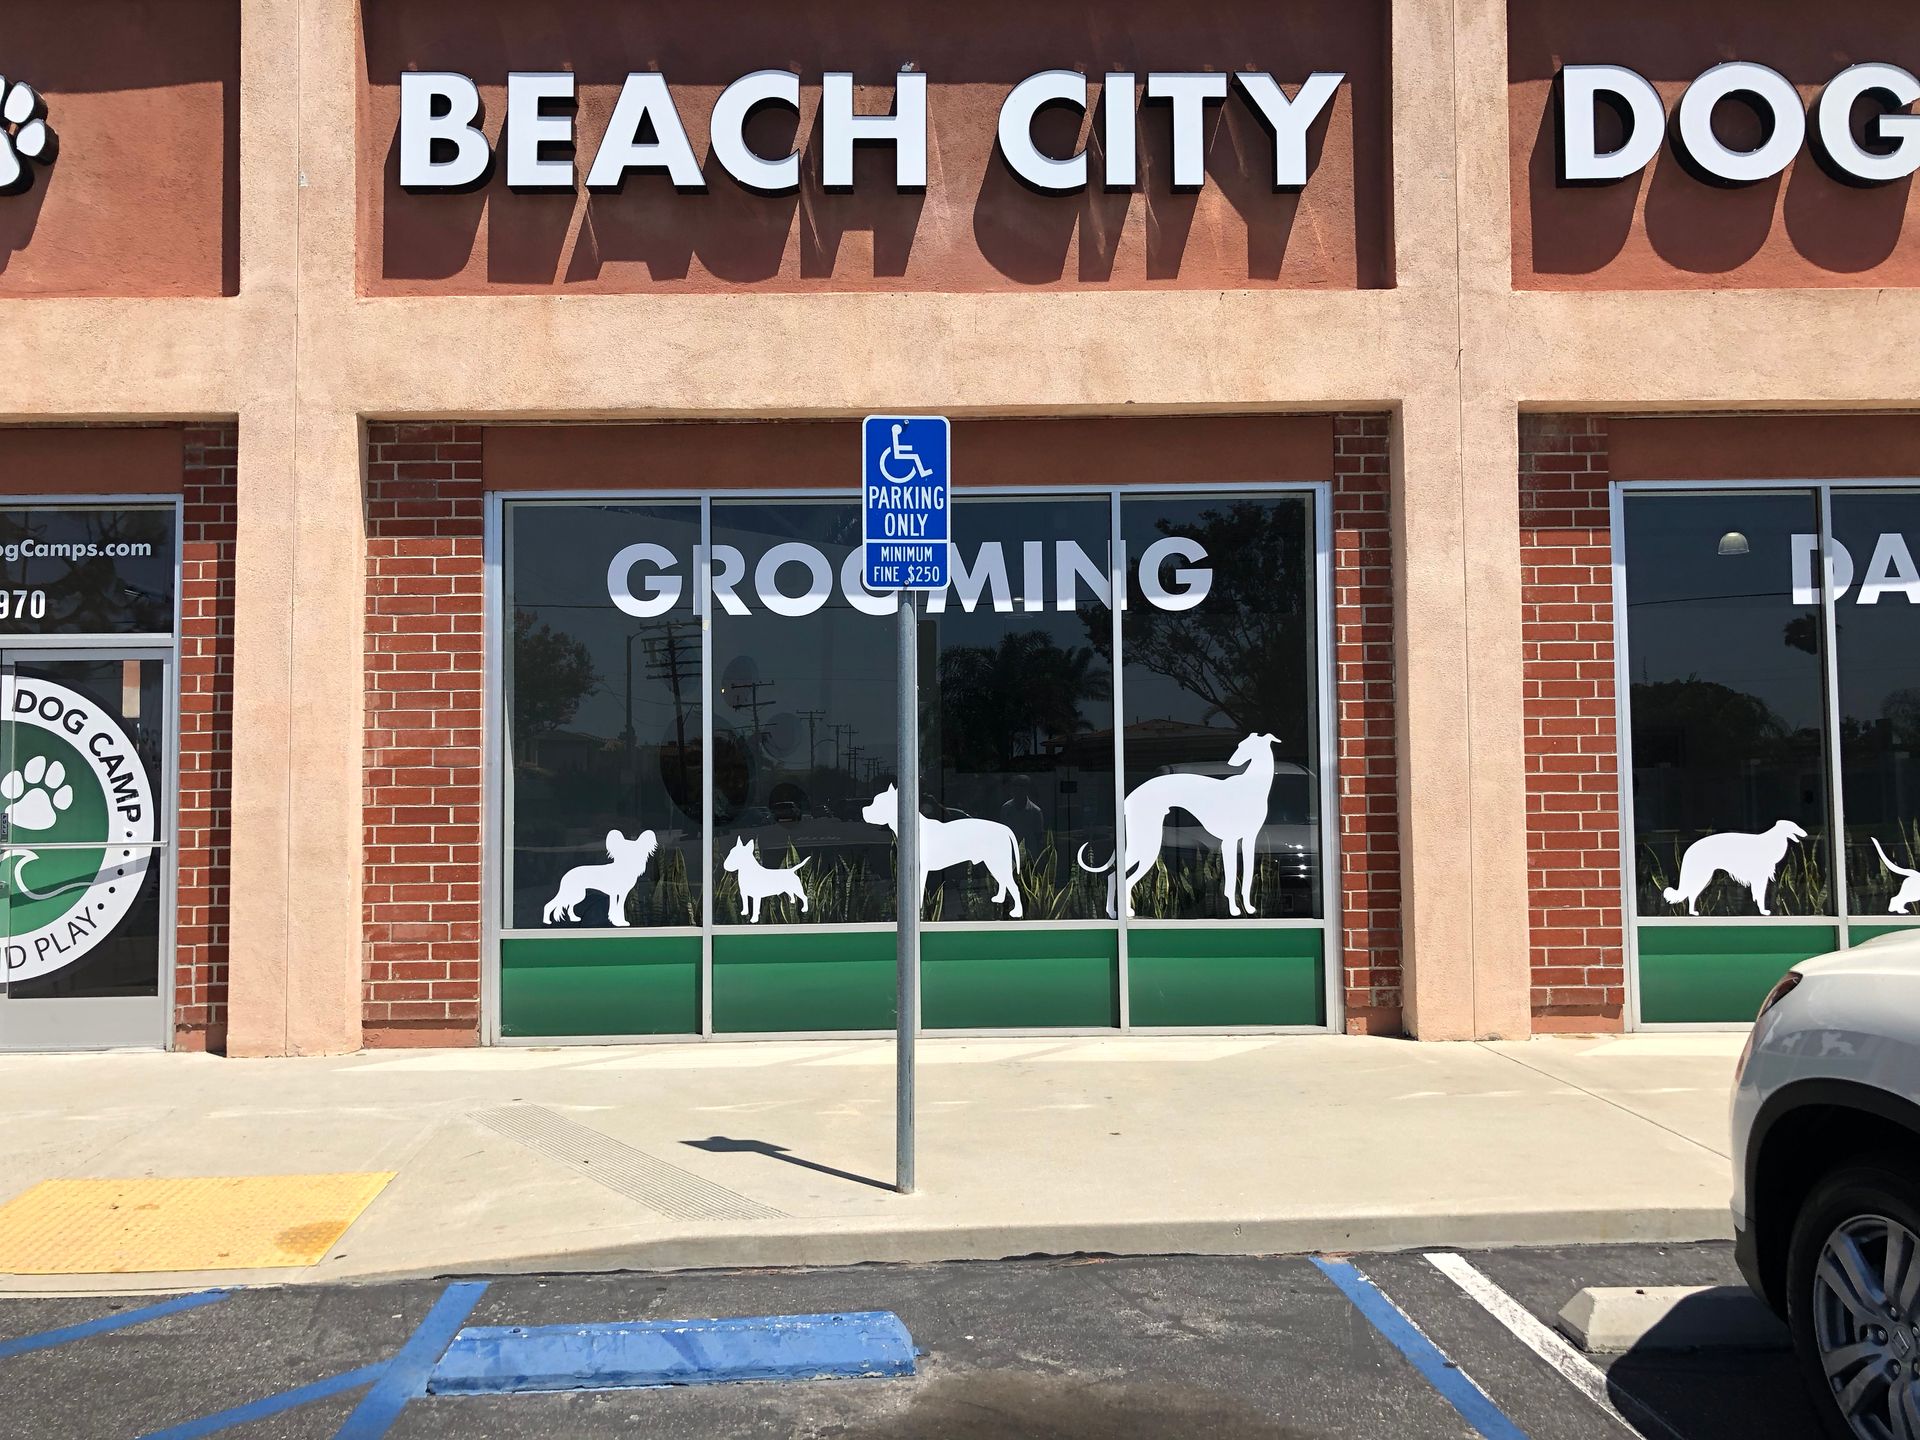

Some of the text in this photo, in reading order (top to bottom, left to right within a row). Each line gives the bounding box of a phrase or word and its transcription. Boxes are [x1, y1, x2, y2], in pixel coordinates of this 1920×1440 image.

[399, 69, 1347, 190] BEACH CITY
[1562, 61, 1920, 181] DOG
[868, 485, 945, 511] PARKING
[884, 512, 929, 537] ONLY
[0, 538, 151, 562] gCamps.com
[880, 546, 933, 562] MINIMUM
[873, 564, 940, 583] FINE $250
[12, 688, 142, 823] DOG CAMP
[34, 906, 98, 962] PLAY
